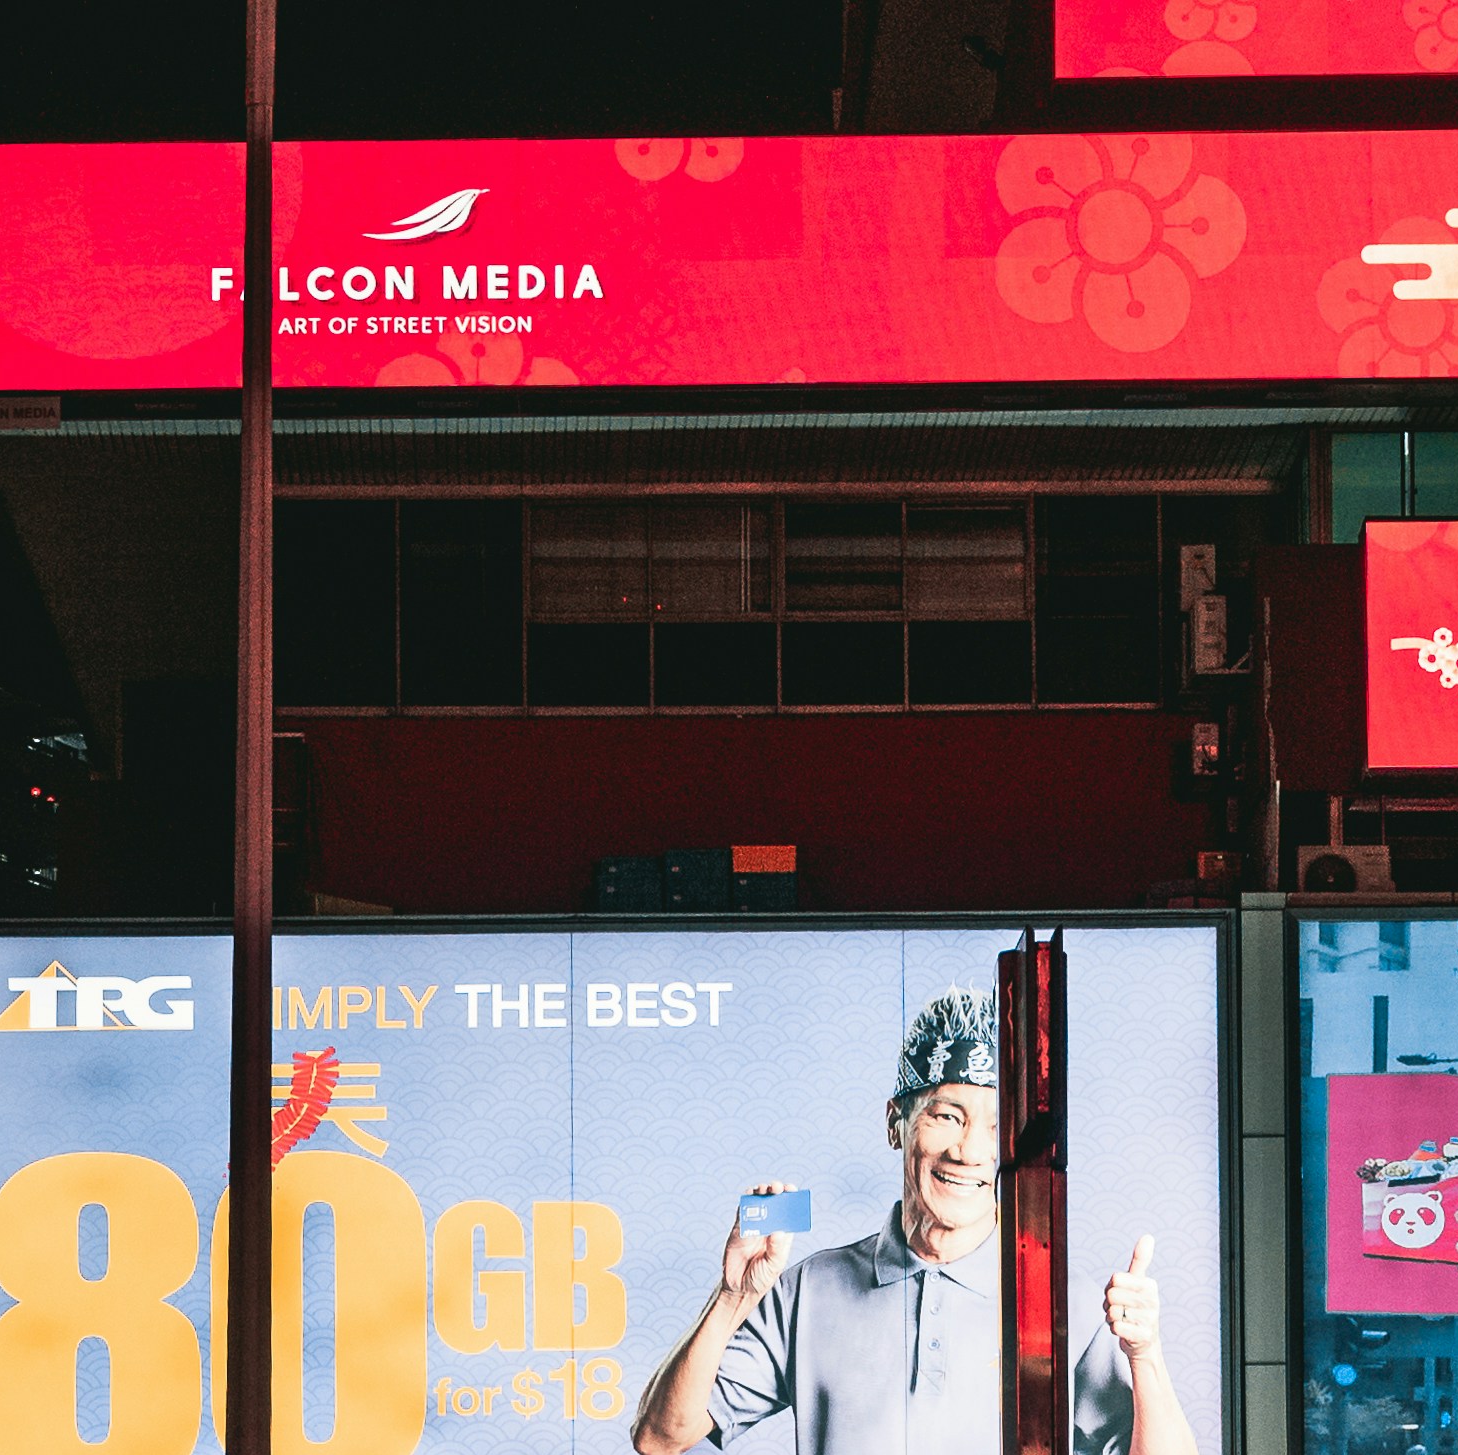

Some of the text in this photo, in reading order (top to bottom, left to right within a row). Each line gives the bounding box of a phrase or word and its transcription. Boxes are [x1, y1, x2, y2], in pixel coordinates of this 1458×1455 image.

[211, 264, 604, 301] FLCON MEDIA
[278, 315, 533, 335] ART OF STREET VISION
[12, 405, 56, 419] MEDIA
[272, 981, 734, 1031] IMPLY THE BEST
[432, 1199, 627, 1355] GB
[435, 1356, 626, 1421] for $18
